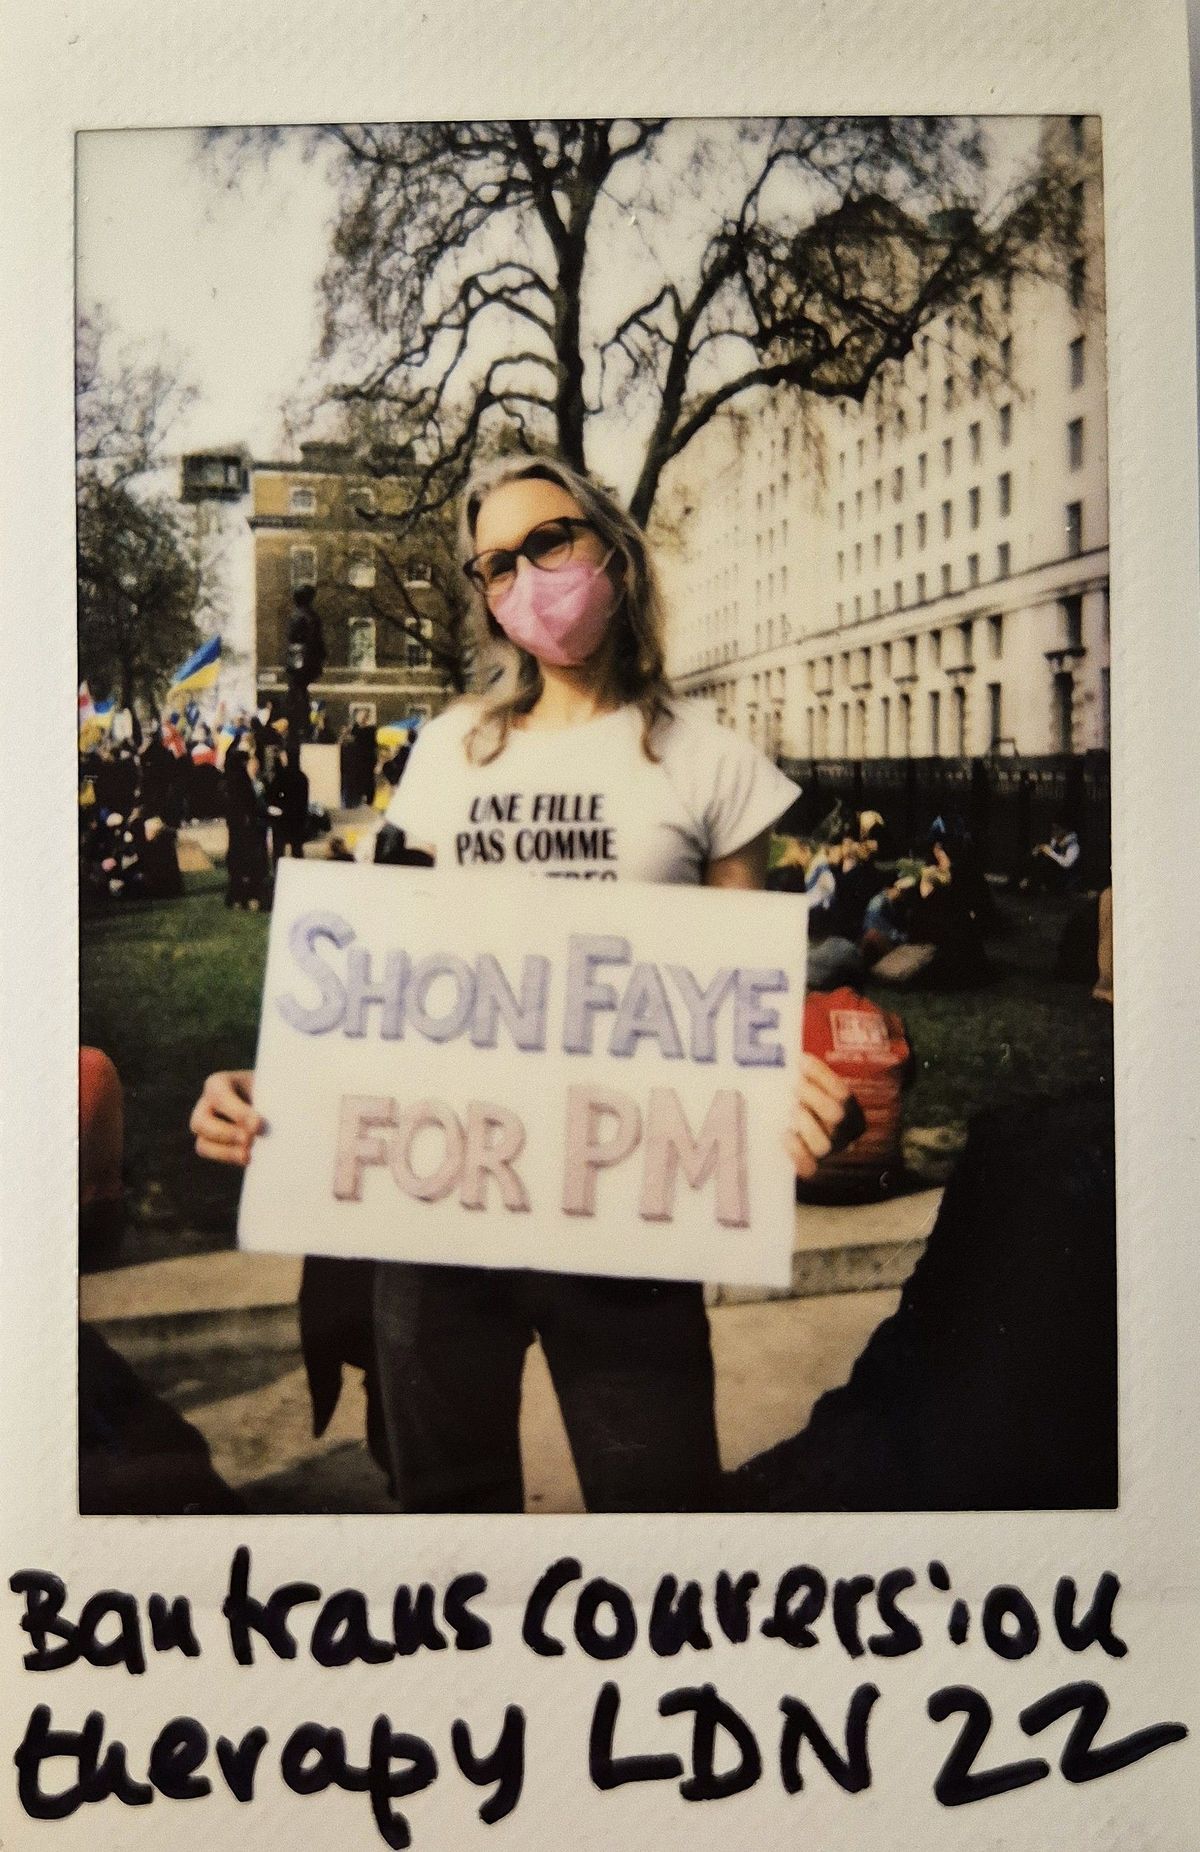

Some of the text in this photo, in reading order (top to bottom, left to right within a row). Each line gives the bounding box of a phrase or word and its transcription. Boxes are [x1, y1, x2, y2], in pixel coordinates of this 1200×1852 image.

[456, 827, 617, 865] PAS COMME
[532, 793, 604, 823] FILLE
[278, 911, 789, 1068] SHON FAYE
[332, 1083, 751, 1228] FOR PM
[222, 1547, 491, 1667] trans
[14, 1681, 1189, 1850] therapy LDN 22
